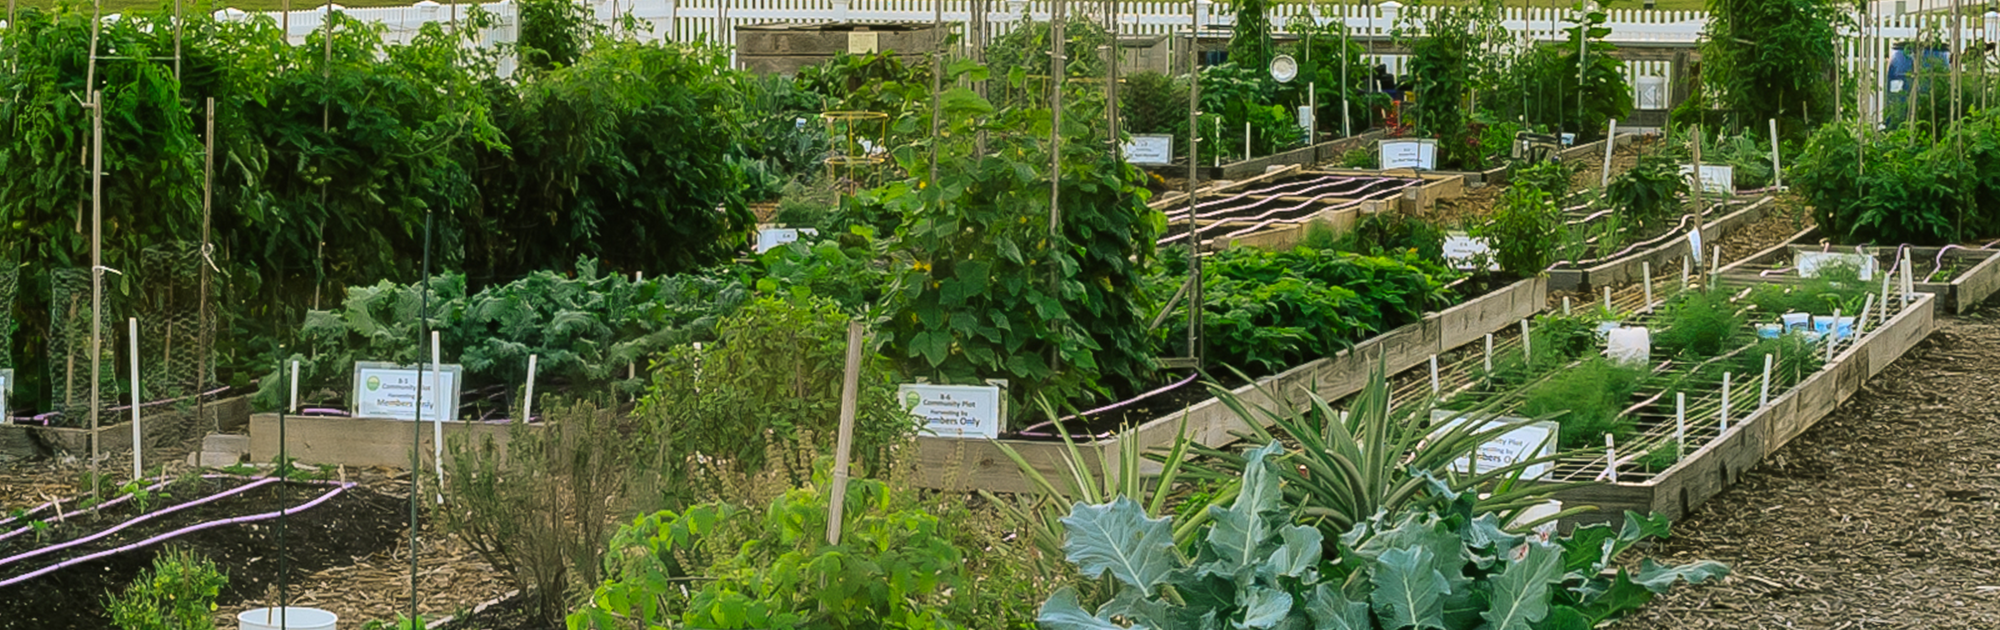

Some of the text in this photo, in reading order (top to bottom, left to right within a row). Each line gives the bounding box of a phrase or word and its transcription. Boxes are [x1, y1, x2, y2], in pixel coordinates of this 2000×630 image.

[382, 383, 416, 392] Community
[377, 399, 413, 408] Members
[923, 399, 960, 408] Community
[930, 409, 960, 418] Harvesting
[960, 417, 980, 428] Only
[1508, 438, 1523, 447] Plot
